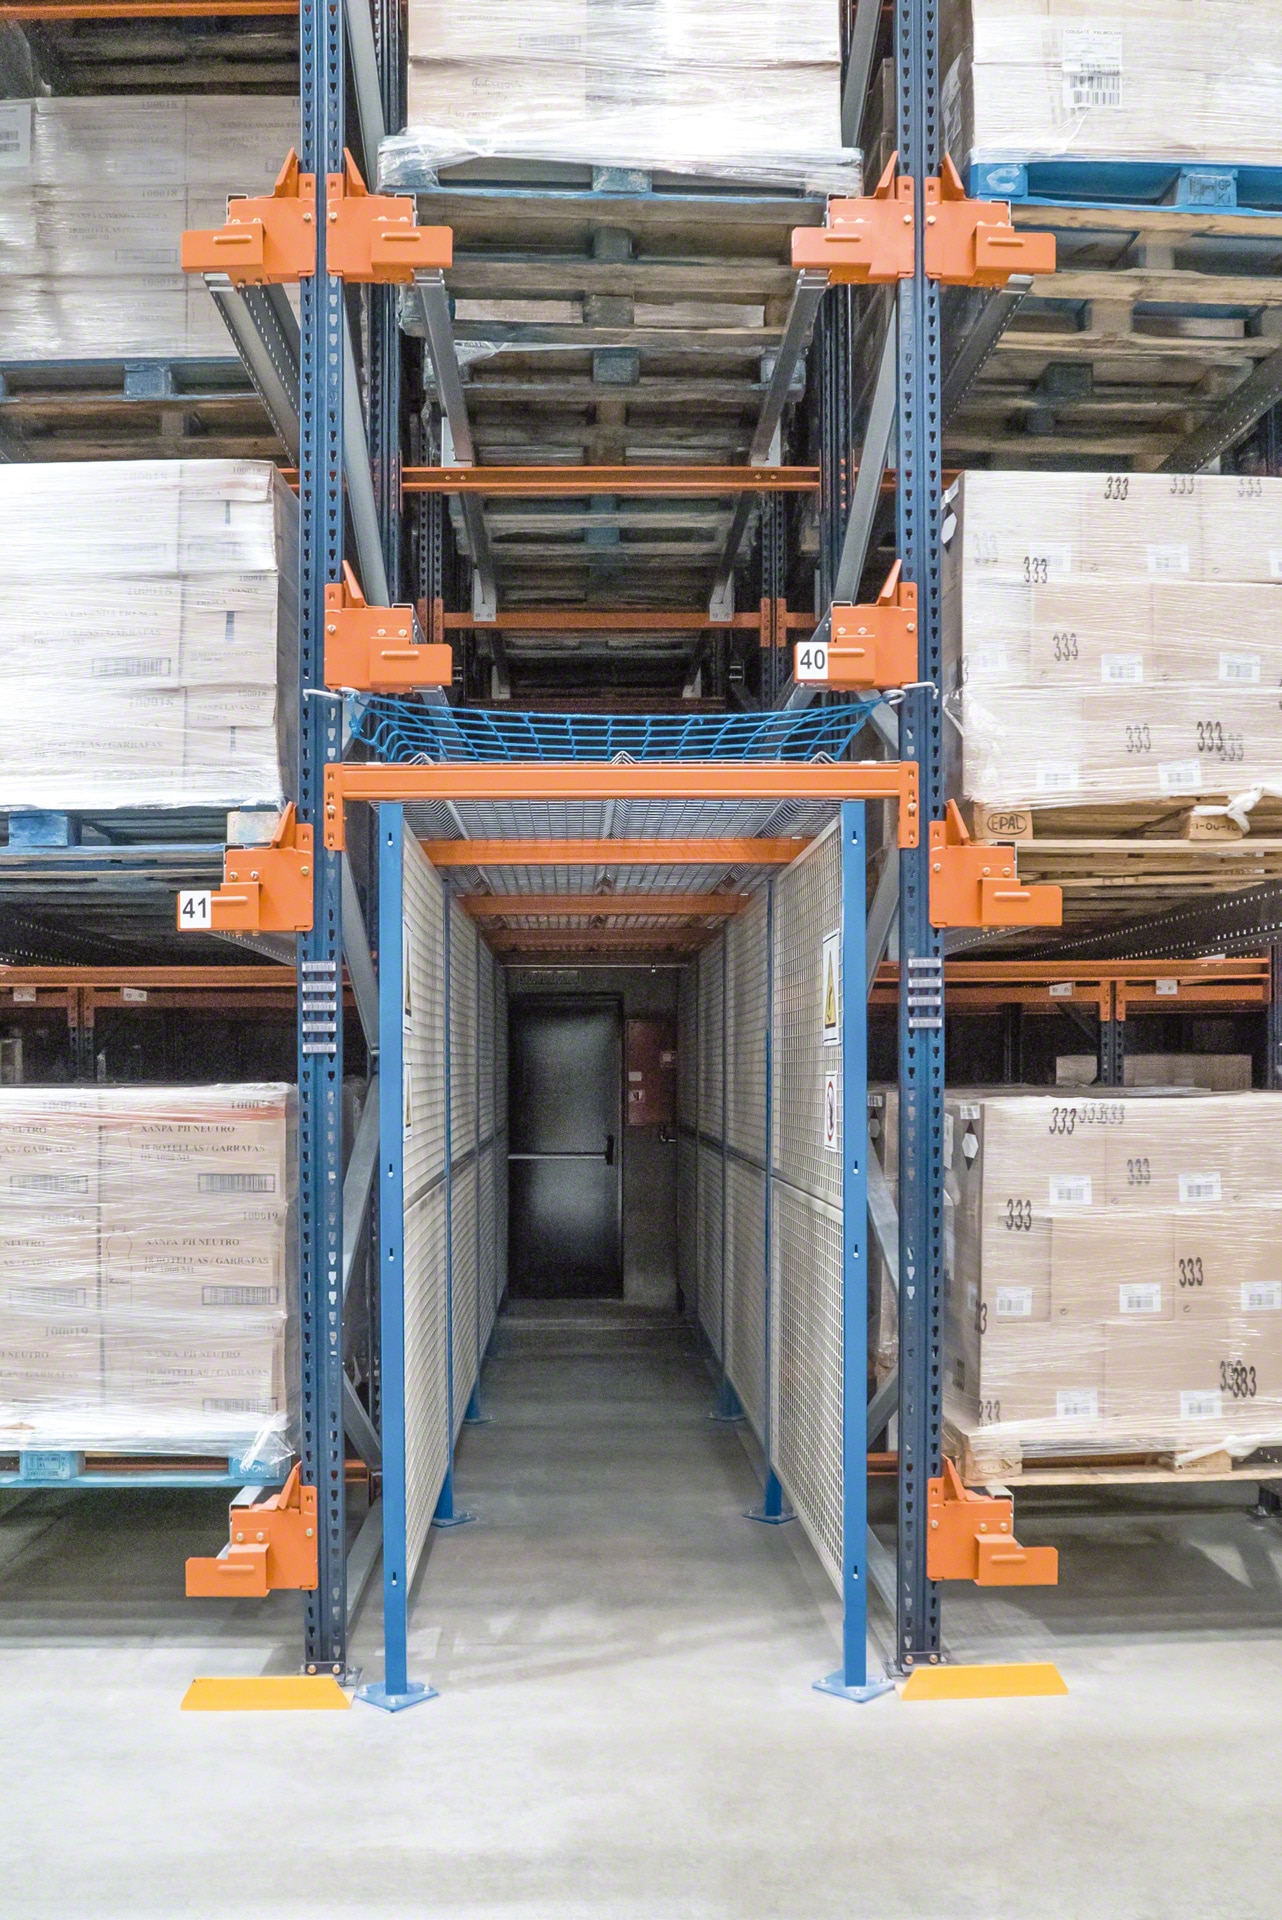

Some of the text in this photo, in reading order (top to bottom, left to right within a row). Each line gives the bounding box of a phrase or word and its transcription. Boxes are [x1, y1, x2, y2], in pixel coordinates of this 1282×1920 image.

[1104, 477, 1130, 501] 333
[1170, 474, 1195, 495] 333
[1237, 478, 1263, 498] 333
[1023, 556, 1048, 583] 333
[801, 649, 824, 669] 40
[1053, 633, 1079, 661] 333
[1125, 723, 1151, 753] 333
[1197, 721, 1223, 752] 333
[991, 814, 1023, 833] EPAL
[182, 898, 206, 918] 41
[193, 1124, 236, 1133] NEUTRO
[1049, 1107, 1077, 1135] 333
[1127, 1157, 1151, 1186] 333
[1006, 1198, 1033, 1231] 333
[198, 1238, 240, 1246] NEUTRO
[1178, 1257, 1204, 1287] 333
[8, 1351, 49, 1359] NEUTRO
